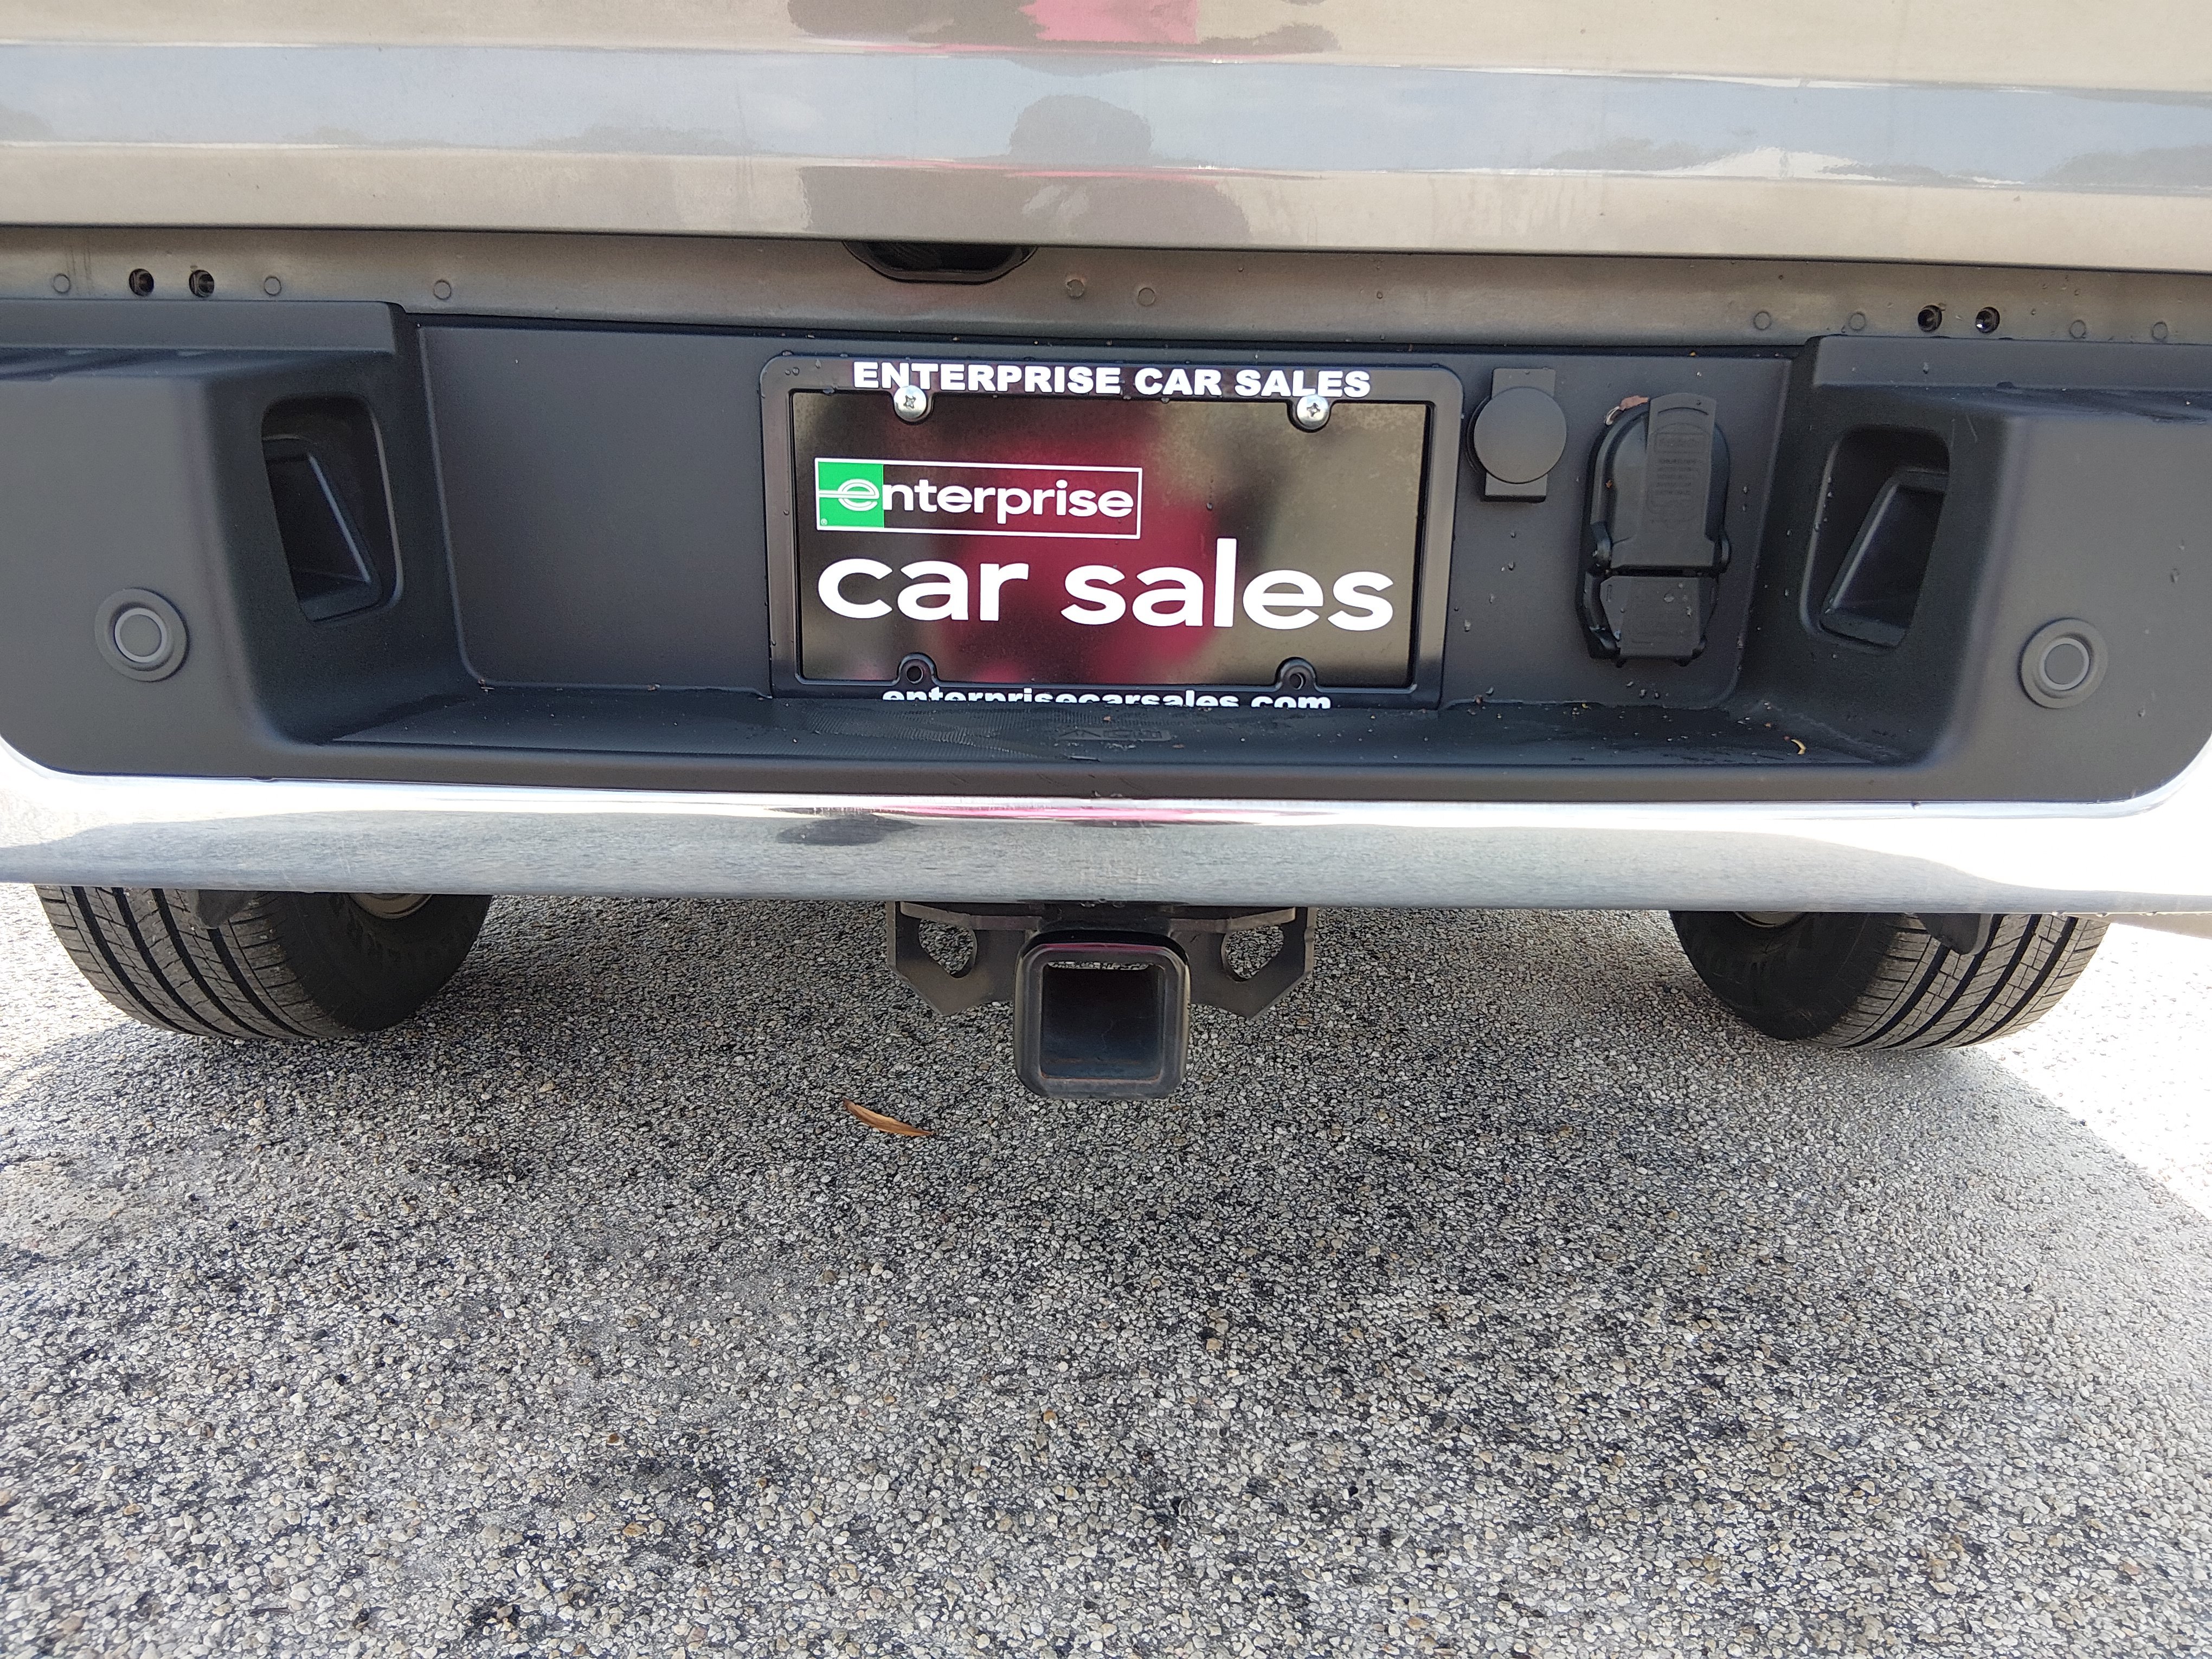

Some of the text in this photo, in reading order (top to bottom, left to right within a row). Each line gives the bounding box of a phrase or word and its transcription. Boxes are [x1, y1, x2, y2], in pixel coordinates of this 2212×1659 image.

[853, 361, 1371, 398] ENTERPRISE CAR SALES
[836, 479, 1134, 524] enterprise
[818, 538, 1394, 631] car sales
[883, 686, 1332, 709] enterrisecarsalescom
